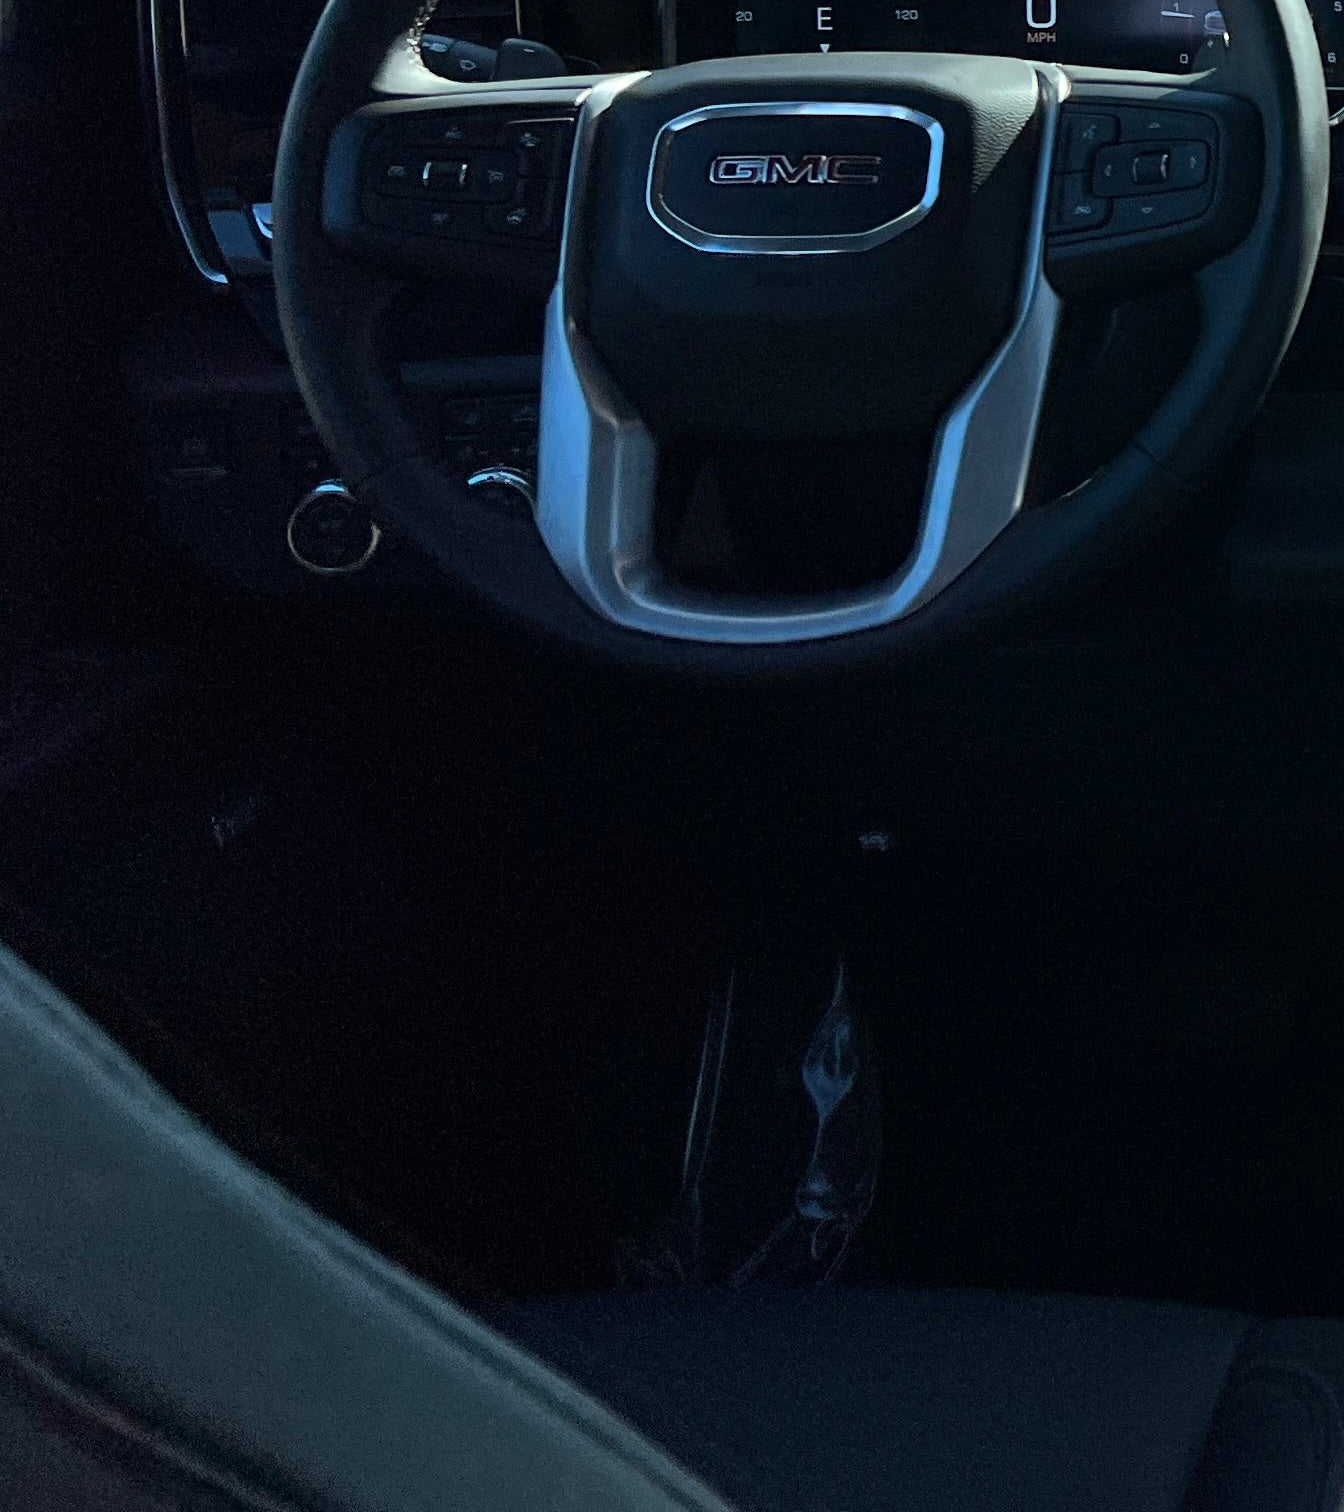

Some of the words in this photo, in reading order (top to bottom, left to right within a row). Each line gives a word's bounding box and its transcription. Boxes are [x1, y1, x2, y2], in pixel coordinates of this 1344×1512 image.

[735, 11, 753, 22] 20
[817, 6, 833, 31] E
[895, 9, 919, 21] 120
[1026, 32, 1057, 44] MPH
[709, 154, 882, 185] GMC
